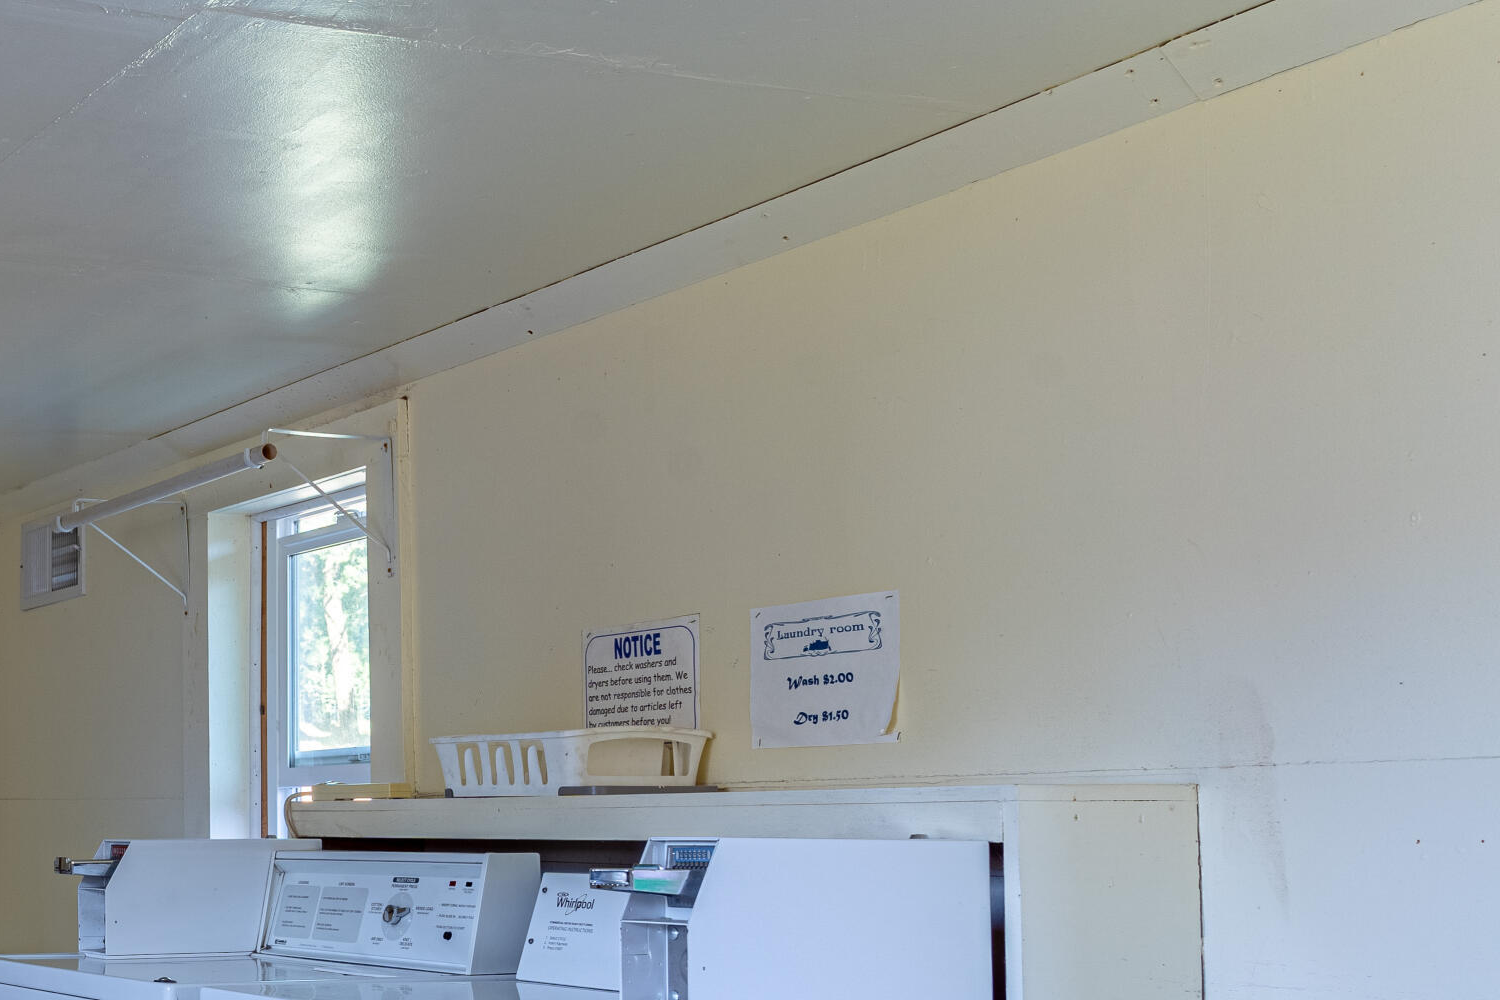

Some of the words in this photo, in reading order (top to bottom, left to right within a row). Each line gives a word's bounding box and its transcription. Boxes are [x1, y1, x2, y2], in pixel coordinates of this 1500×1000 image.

[776, 626, 825, 641] Laundry
[829, 622, 865, 634] room
[614, 633, 662, 660] NOTICE
[614, 661, 634, 672] check
[634, 659, 663, 670] washers
[664, 657, 677, 667] and
[588, 679, 609, 690] dryers
[610, 676, 633, 687] before
[634, 674, 652, 686] using
[653, 673, 673, 682] them.
[675, 671, 688, 681] We
[787, 674, 820, 690] Wash
[823, 672, 854, 686] $2.00
[588, 693, 599, 702] are
[601, 692, 612, 701] not
[613, 688, 651, 701] responsible
[653, 687, 665, 696] for
[666, 685, 692, 696] clothes
[588, 706, 616, 717] damaged
[617, 703, 629, 713] due
[631, 703, 638, 712] to
[639, 701, 667, 712] articles
[668, 700, 683, 710] left
[793, 711, 818, 725] Dry
[821, 709, 850, 722] $1.50
[631, 715, 655, 726] before
[656, 714, 672, 726] you!
[556, 896, 595, 911] Whirlpool
